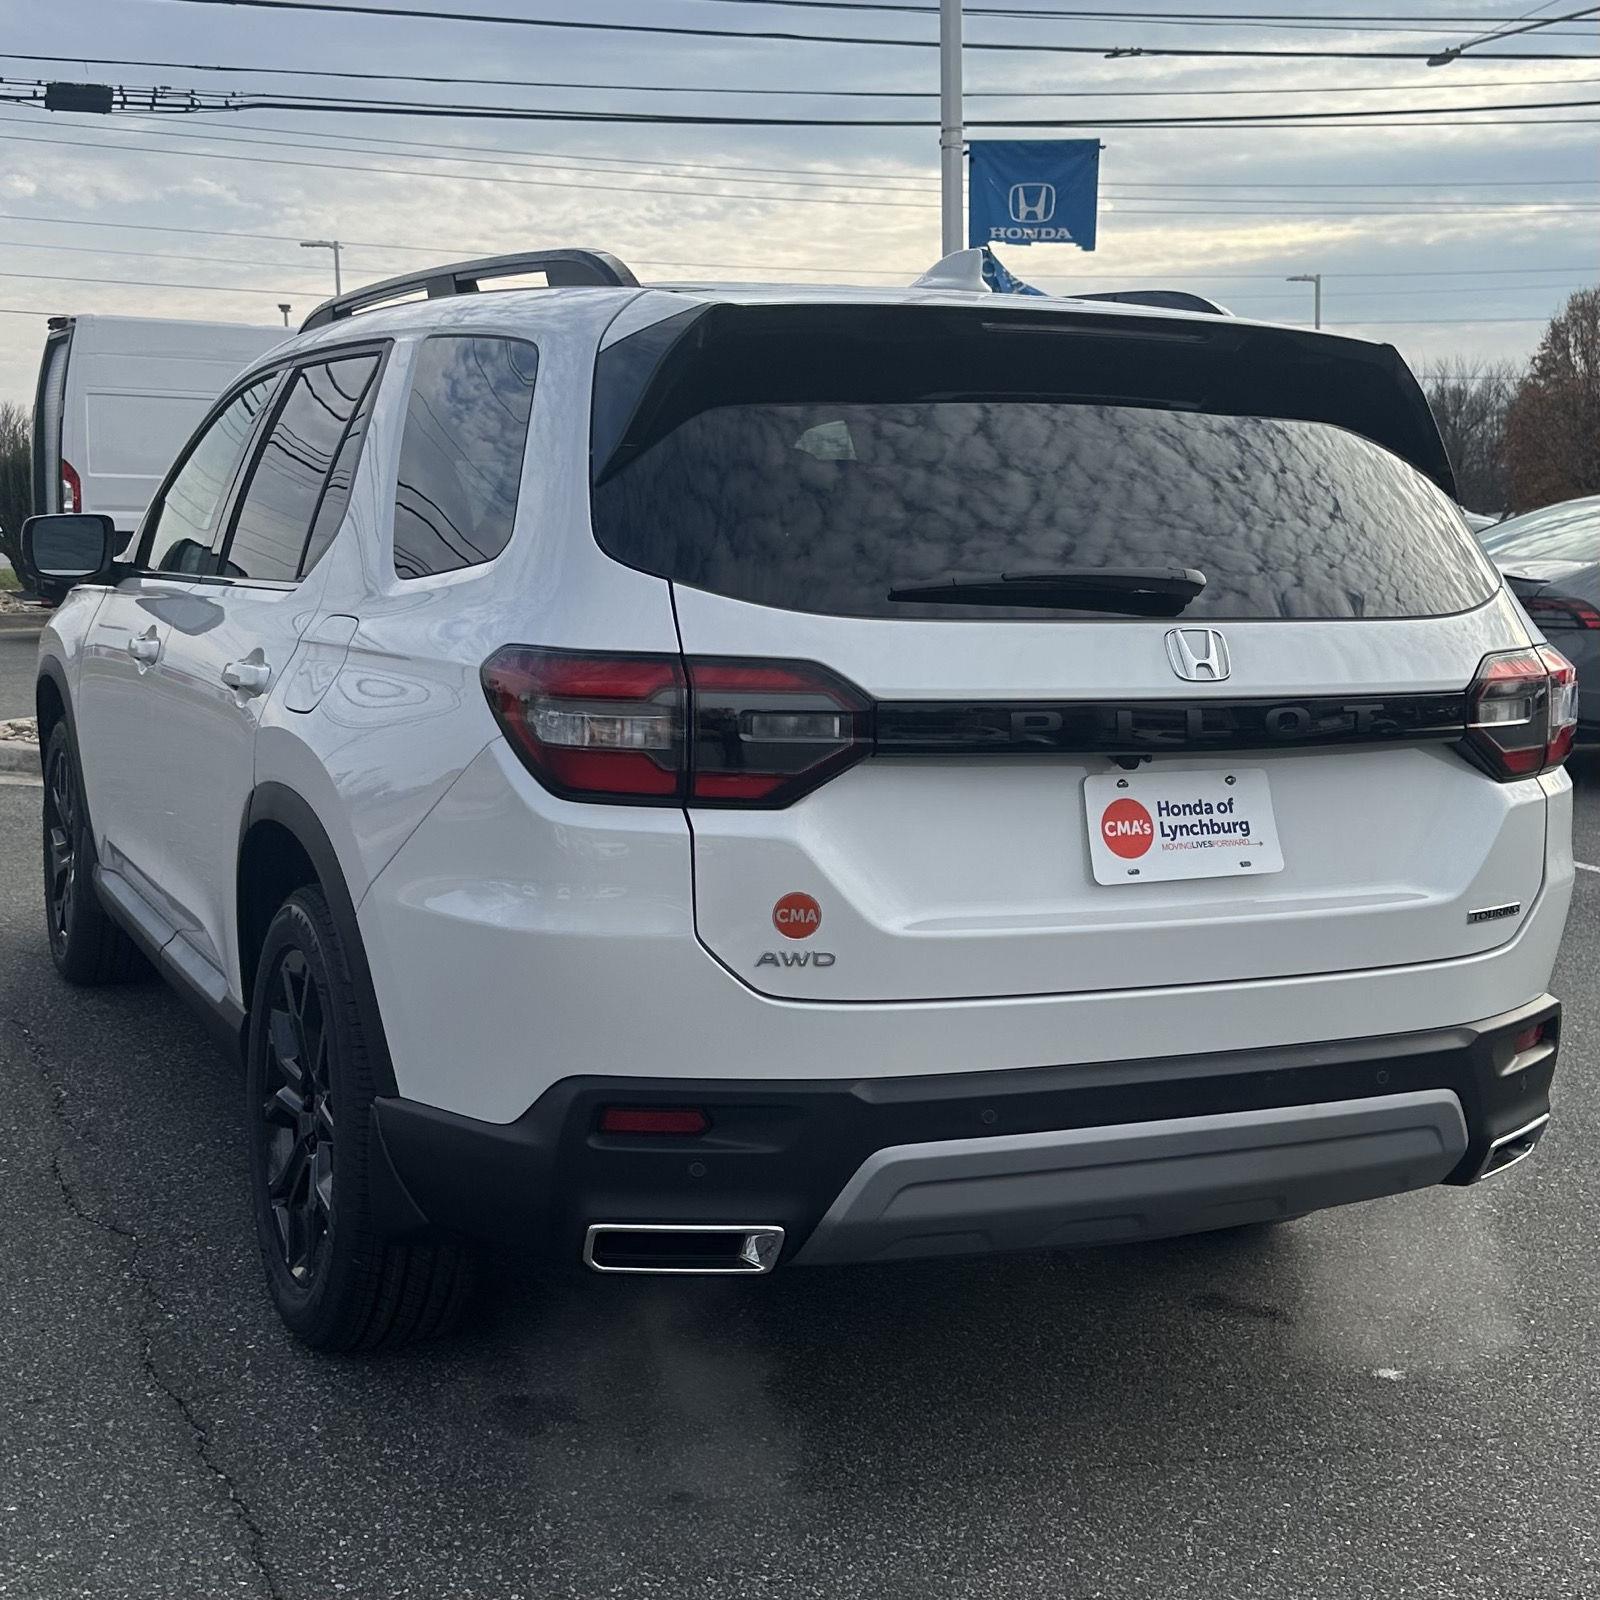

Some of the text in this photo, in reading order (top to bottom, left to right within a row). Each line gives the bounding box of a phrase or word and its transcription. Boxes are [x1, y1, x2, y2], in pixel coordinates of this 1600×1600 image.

[989, 227, 1073, 240] HONDA
[1010, 704, 1385, 744] PILOT
[1157, 798, 1234, 817] Honda of
[1104, 819, 1151, 837] CMA's
[1159, 818, 1251, 841] Lynchburg
[776, 908, 818, 923] CMA
[754, 951, 836, 967] AWD
